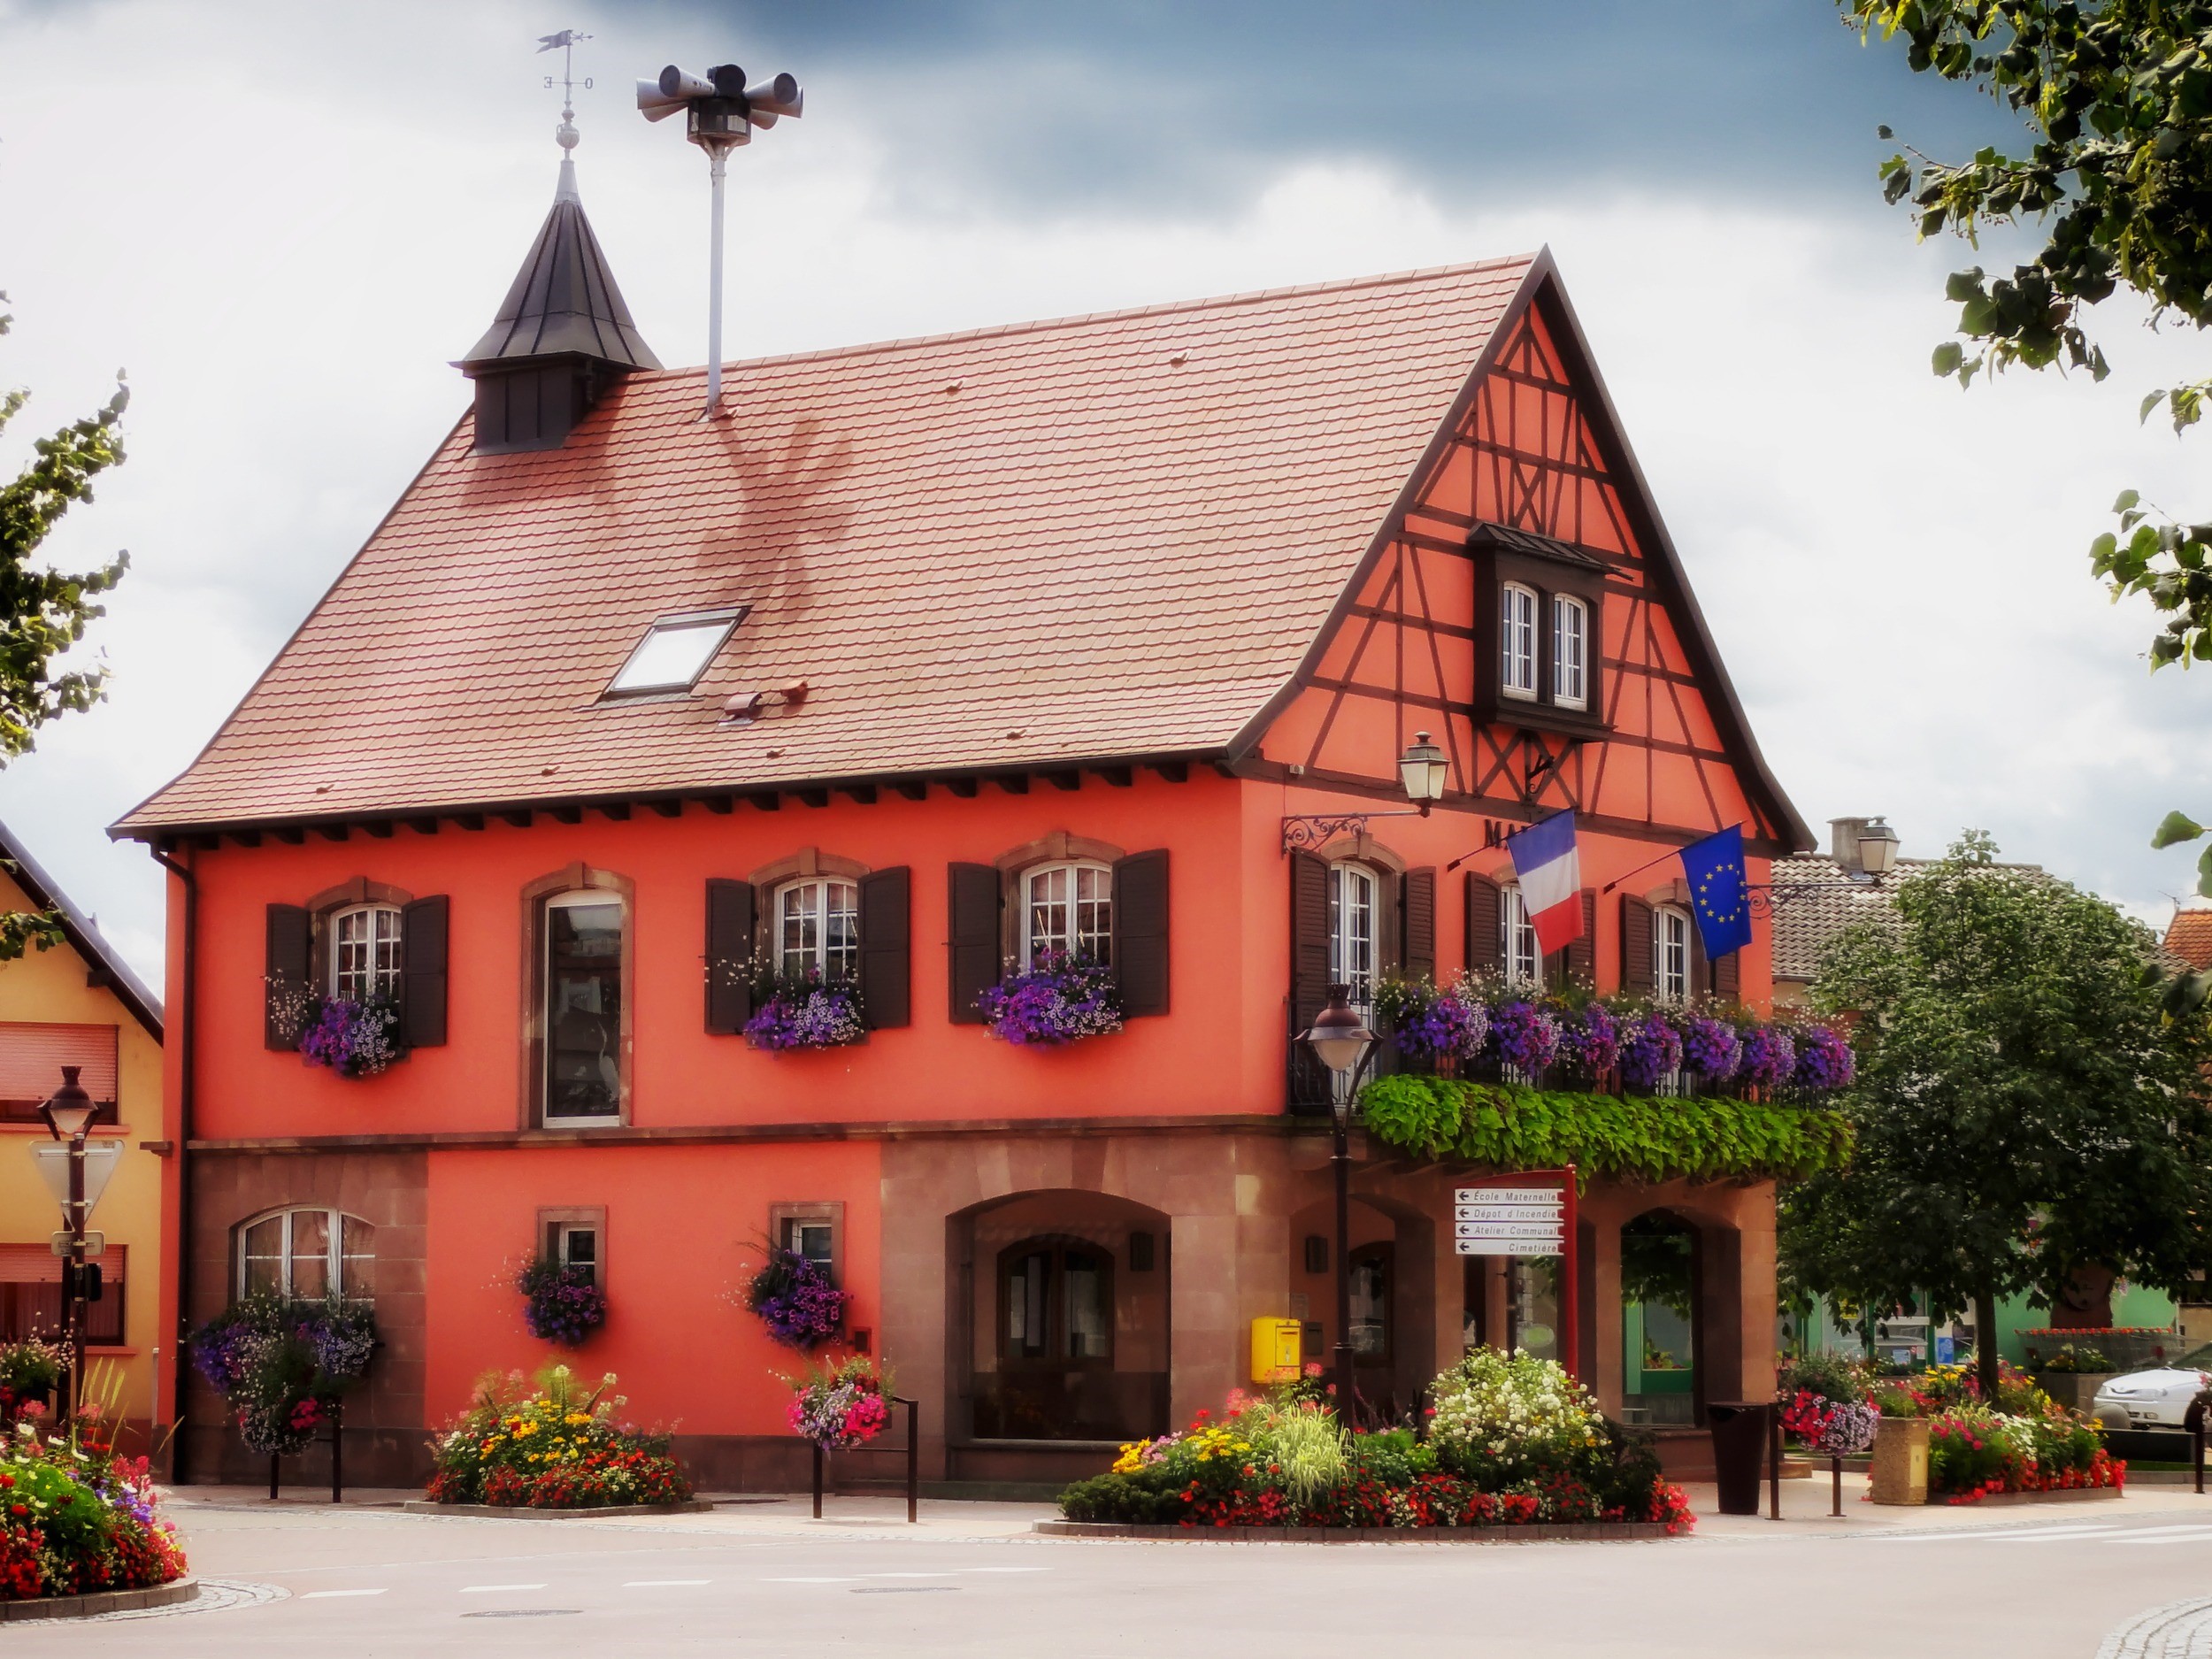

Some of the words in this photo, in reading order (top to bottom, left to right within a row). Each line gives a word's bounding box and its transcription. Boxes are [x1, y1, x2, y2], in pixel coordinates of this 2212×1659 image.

[1474, 1190, 1499, 1201] École
[1505, 1192, 1556, 1202] Maternelle
[1474, 1225, 1505, 1234] Atelier
[1509, 1225, 1557, 1235] Communal
[1509, 1243, 1557, 1253] Cimetière
